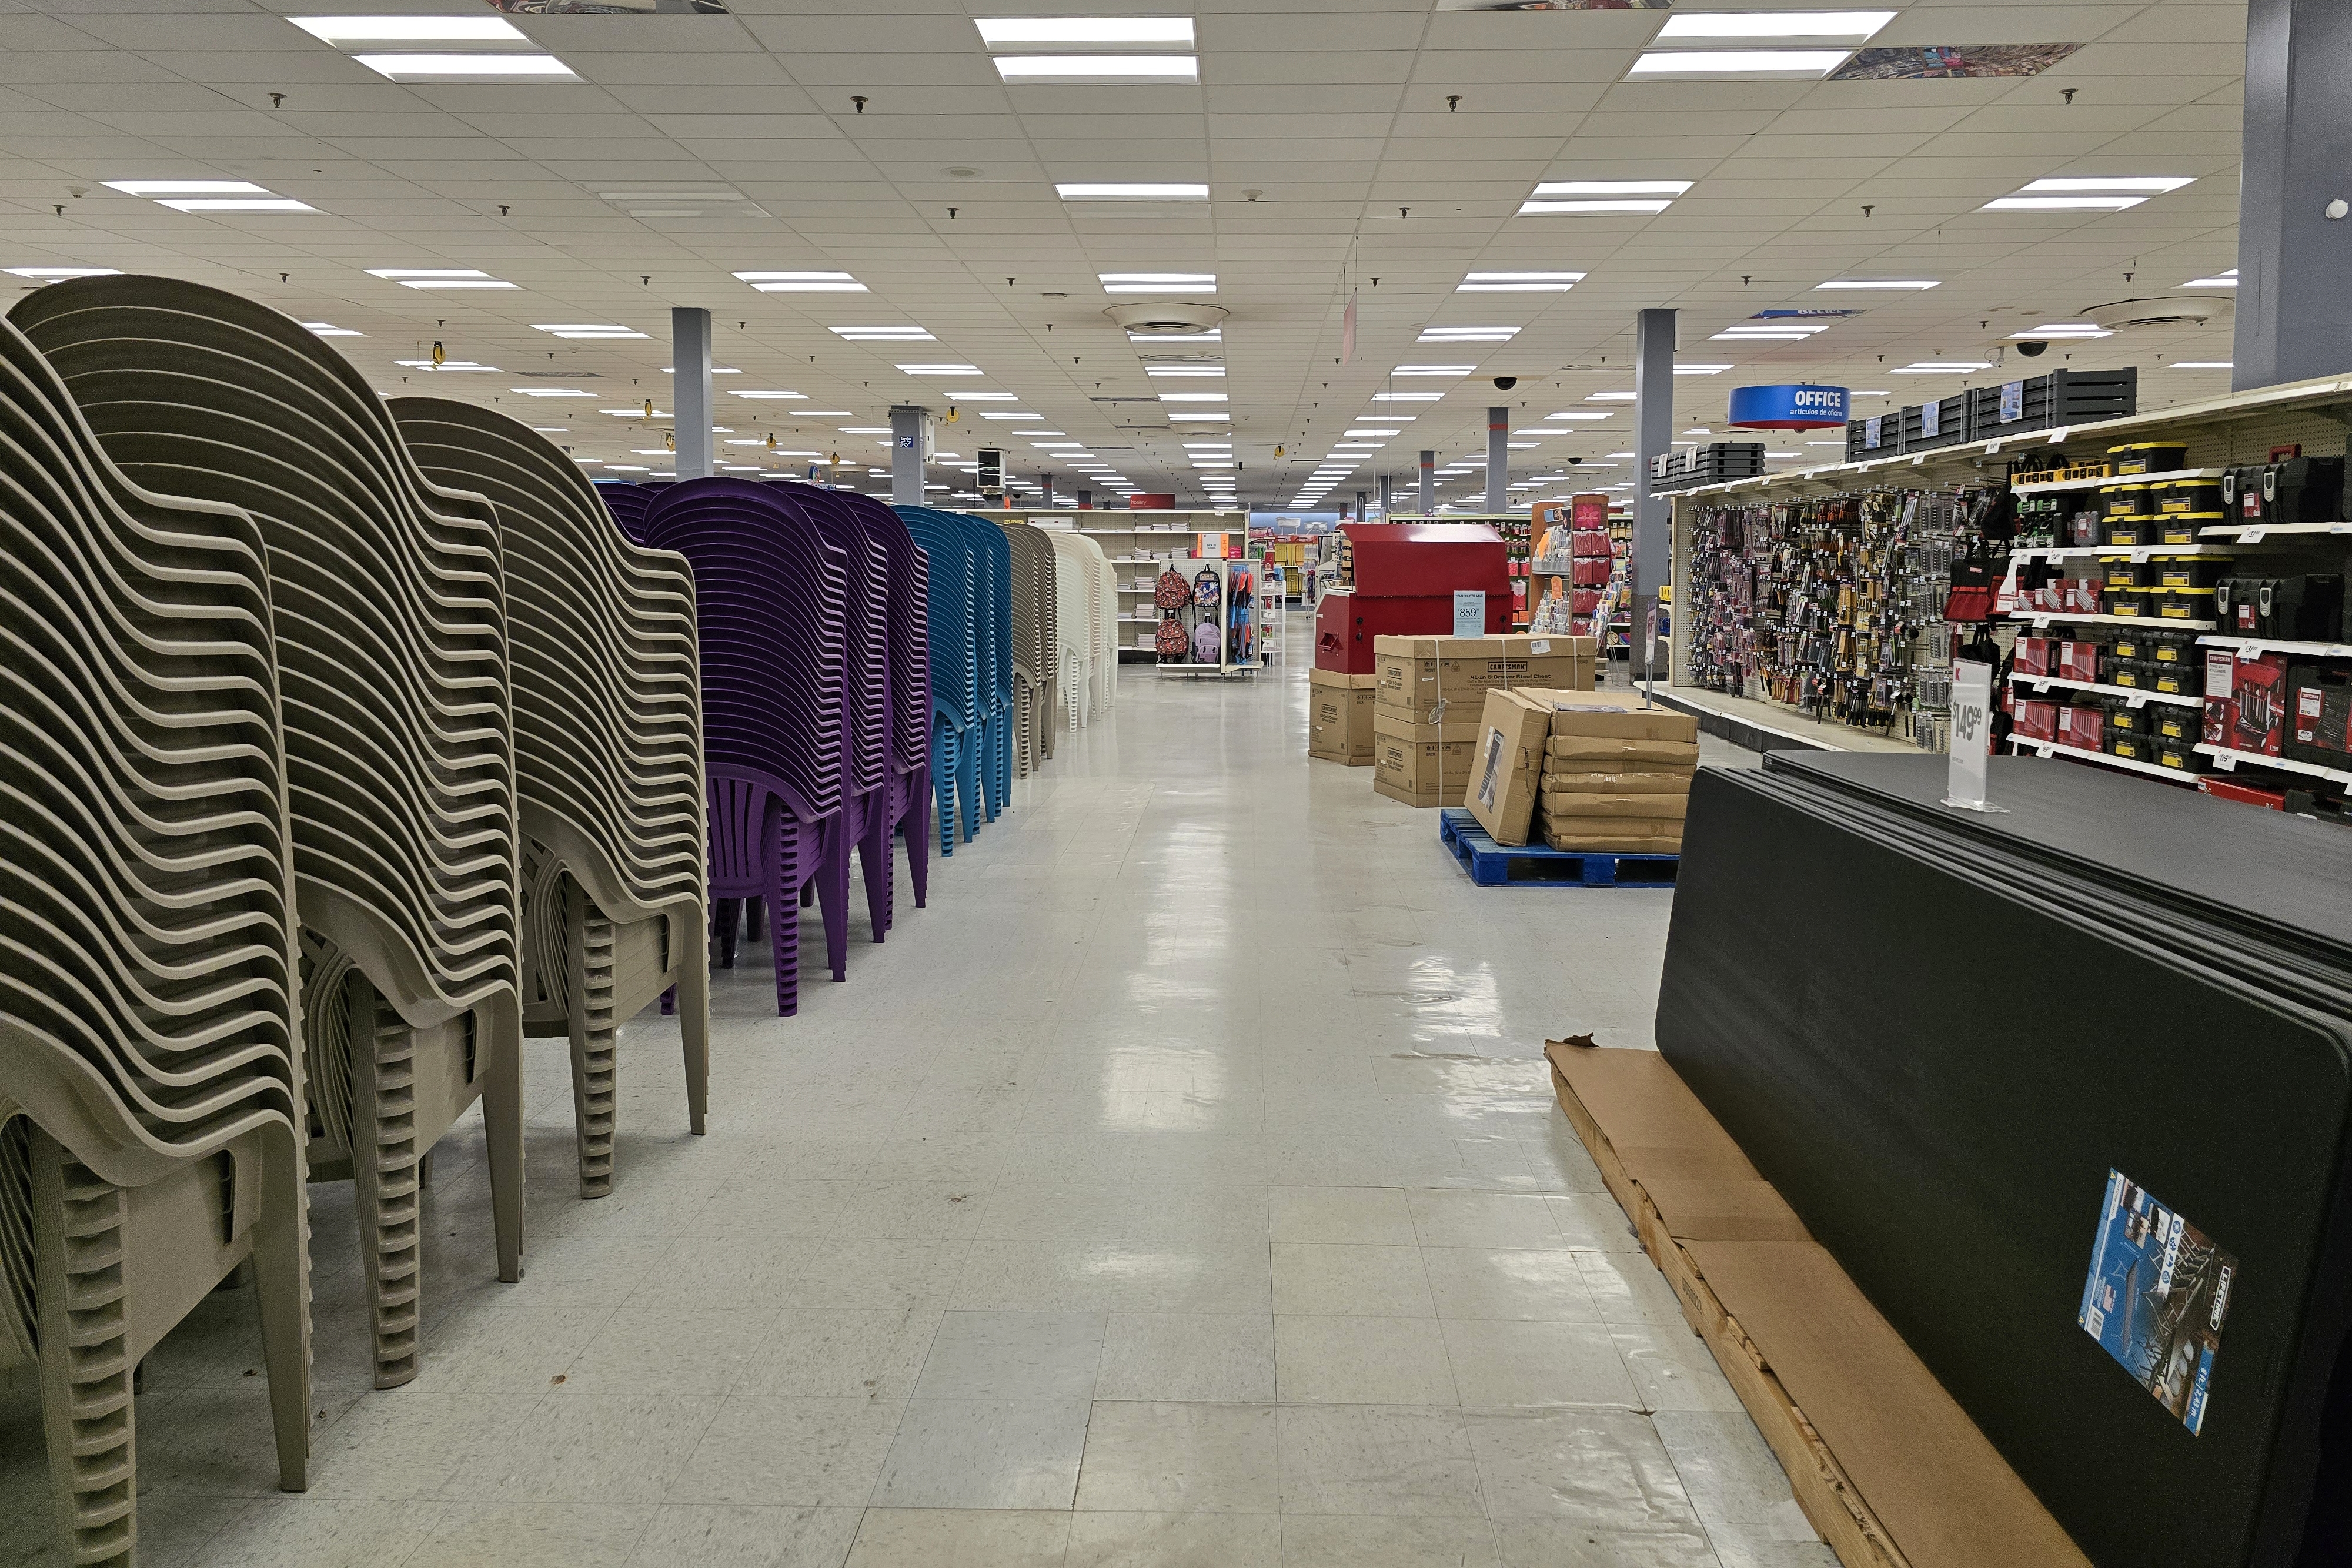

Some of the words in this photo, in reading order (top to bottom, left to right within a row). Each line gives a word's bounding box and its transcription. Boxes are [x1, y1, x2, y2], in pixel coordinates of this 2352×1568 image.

[1795, 390, 1840, 407] OFFICE
[1956, 667, 1960, 681] K
[2213, 1273, 2228, 1323] LIFETIME
